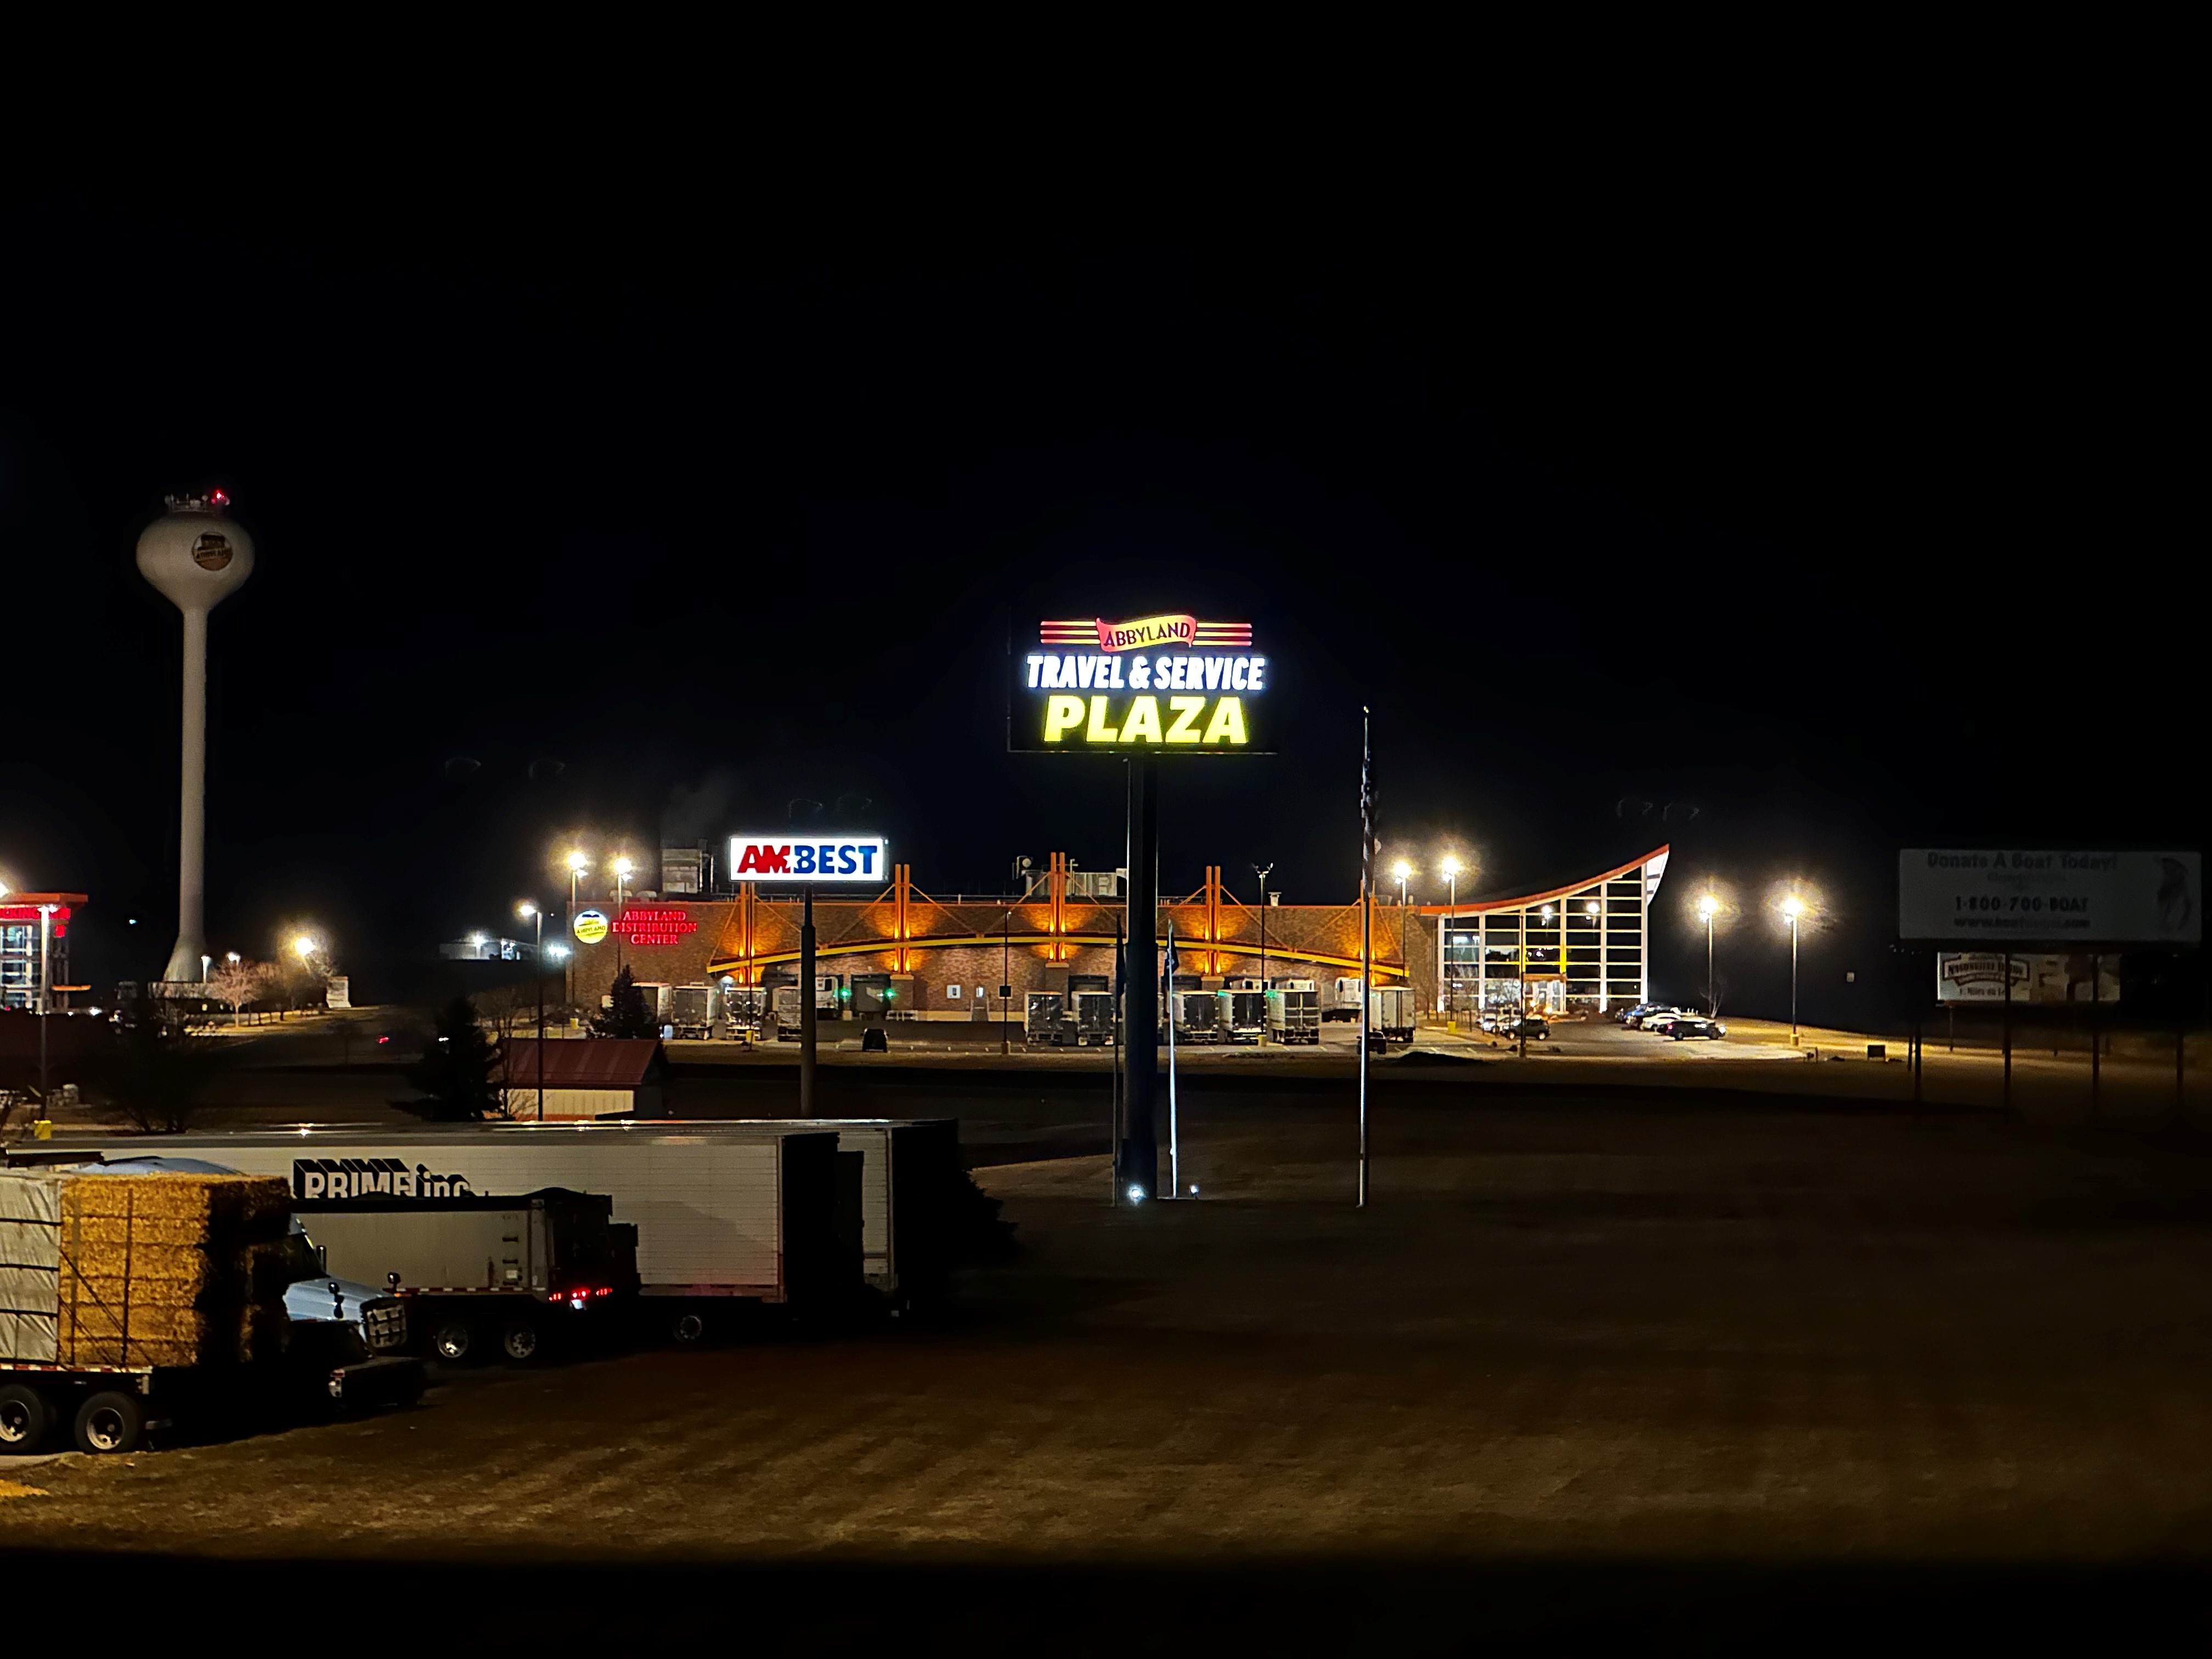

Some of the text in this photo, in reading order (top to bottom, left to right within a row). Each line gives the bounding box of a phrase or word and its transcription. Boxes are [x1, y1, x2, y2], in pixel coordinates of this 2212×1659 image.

[1103, 622, 1191, 648] ABBYLAND
[1026, 655, 1266, 690] TRAVEL & SERVICE
[1043, 695, 1248, 744] PLAZA
[1927, 851, 1989, 868] Donate
[1993, 852, 2007, 869] A
[2011, 852, 2052, 869] Boat
[623, 911, 687, 921] ABBYLAND
[612, 922, 698, 933] DISTRIBUTION
[630, 934, 679, 945] CENTER
[294, 1159, 410, 1199] PRIME
